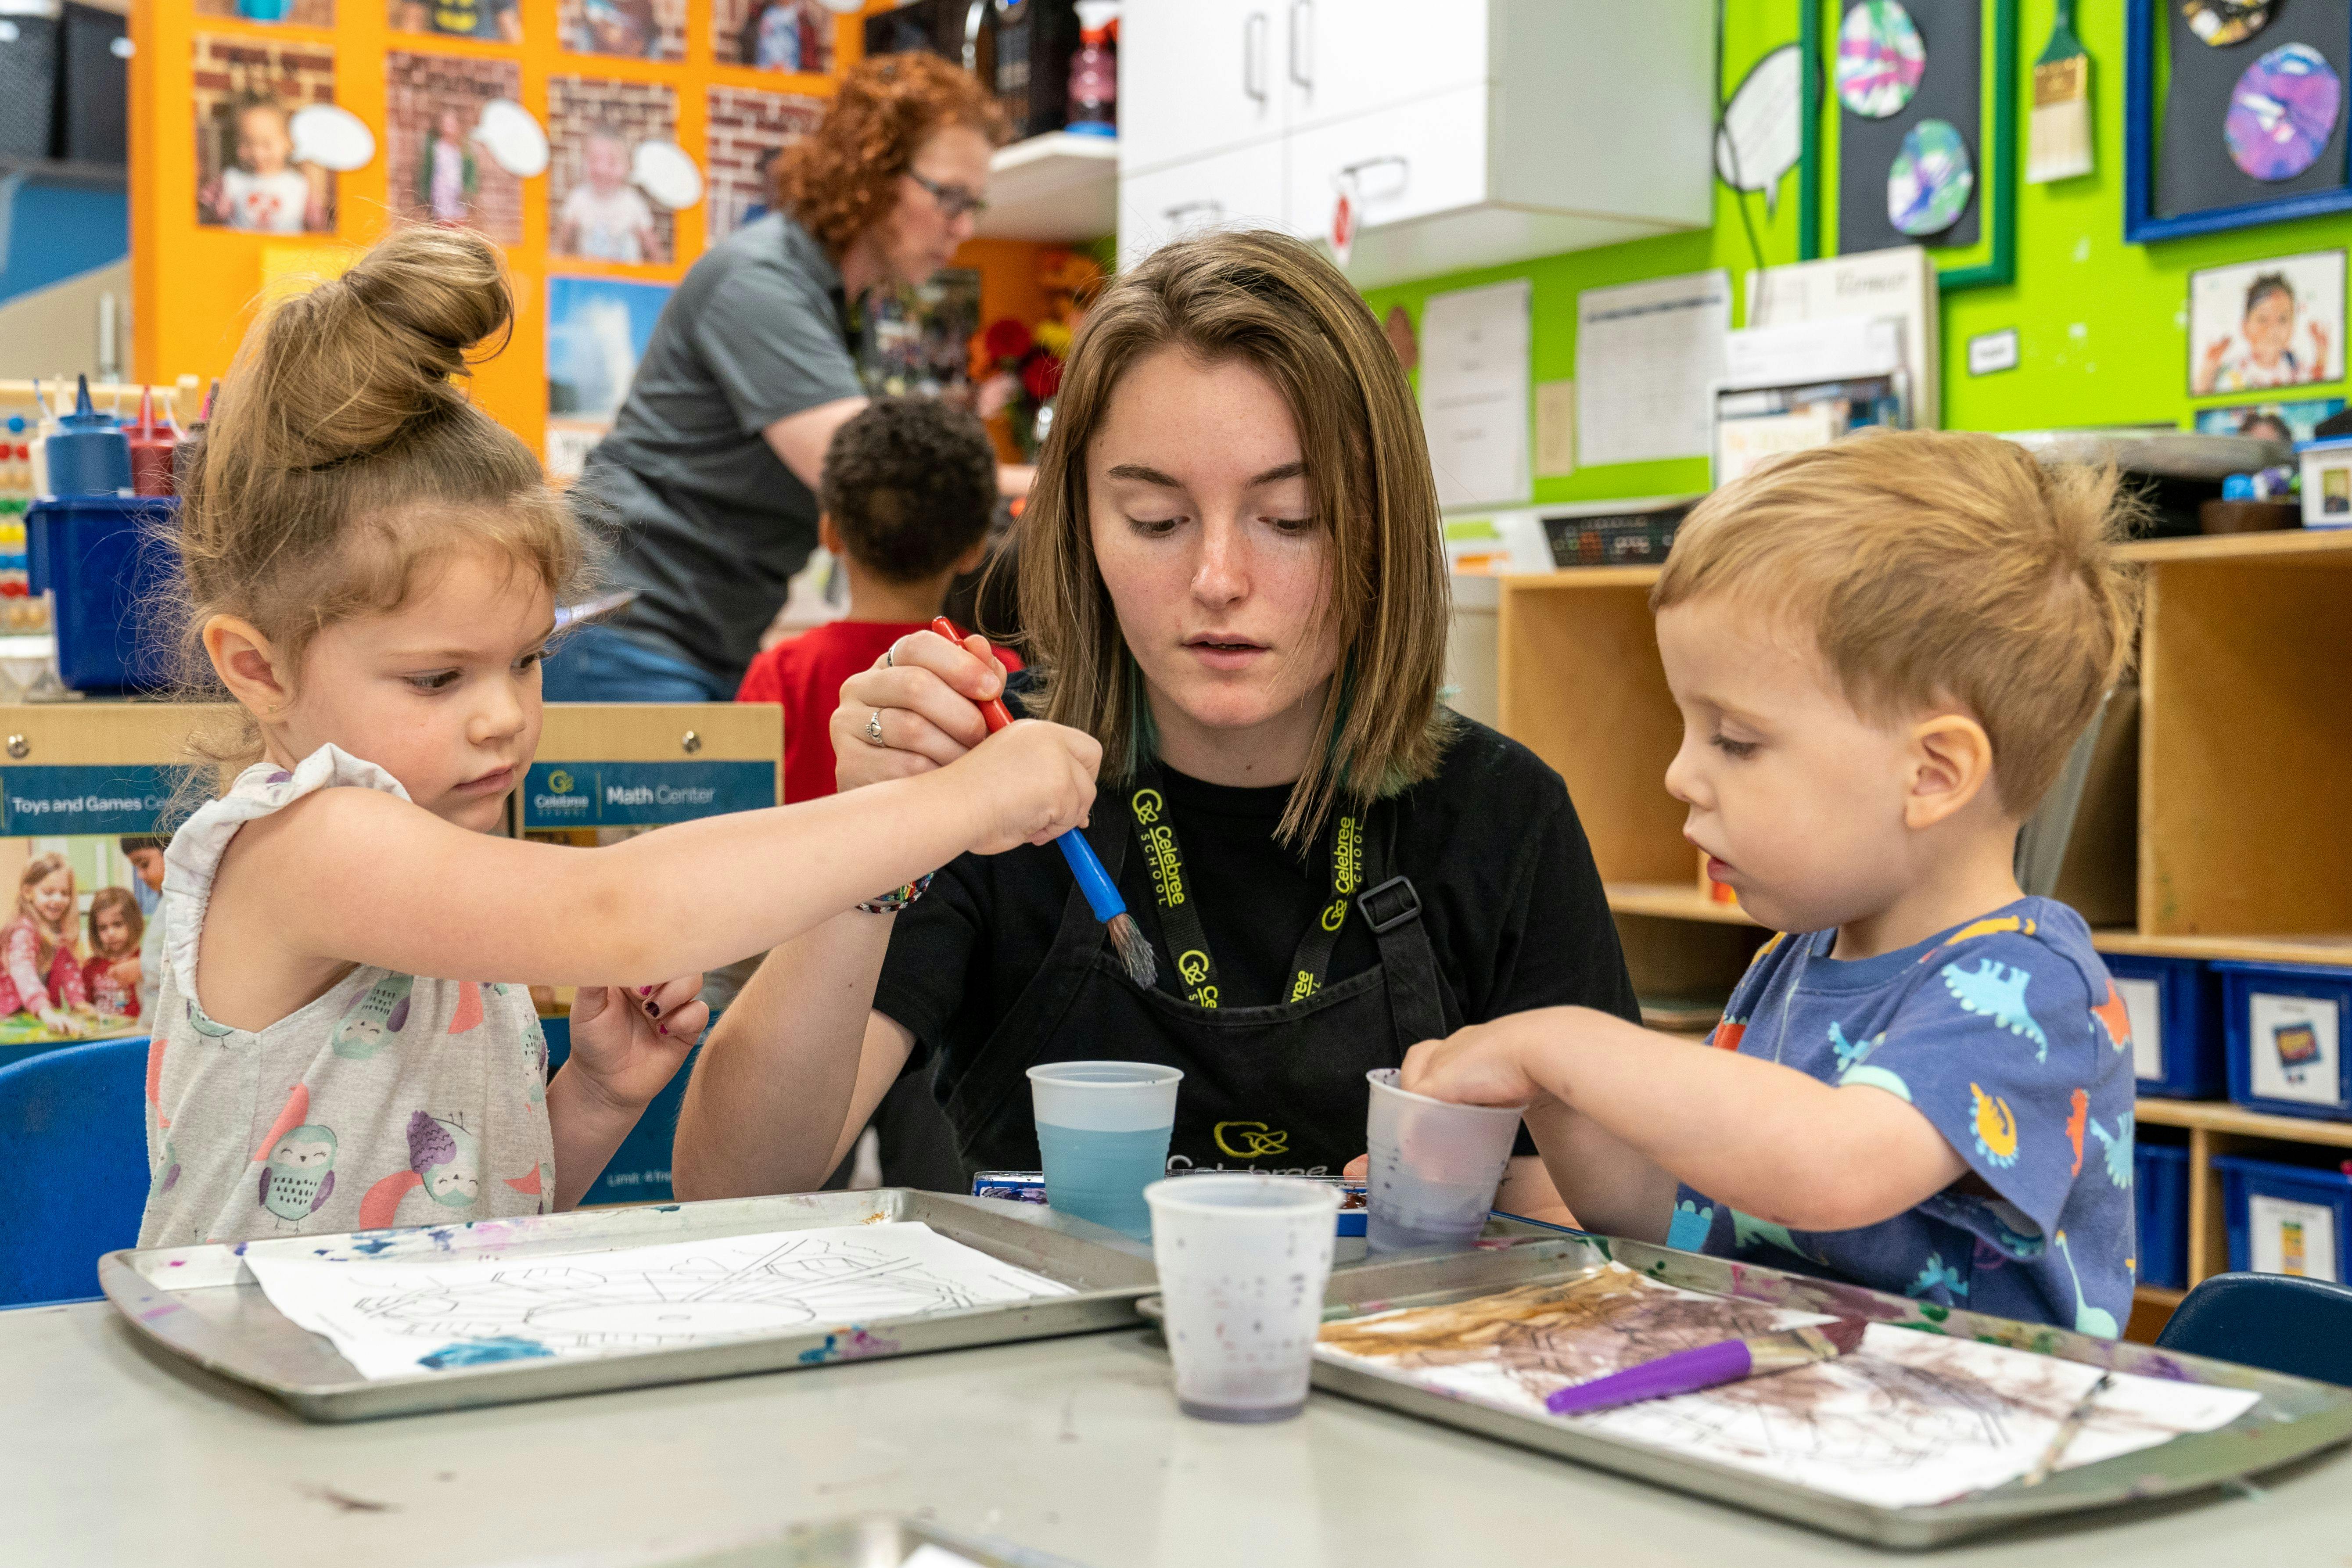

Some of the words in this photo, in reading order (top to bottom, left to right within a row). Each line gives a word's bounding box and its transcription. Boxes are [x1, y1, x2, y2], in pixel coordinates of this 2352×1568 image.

[12, 797, 49, 815] Toys
[52, 796, 83, 812] and
[86, 795, 142, 812] Games
[607, 785, 654, 805] Math
[655, 785, 715, 804] Center
[1141, 833, 1167, 905] SCHOOL
[1155, 826, 1185, 905] Celebree
[1334, 816, 1351, 893] Celebree
